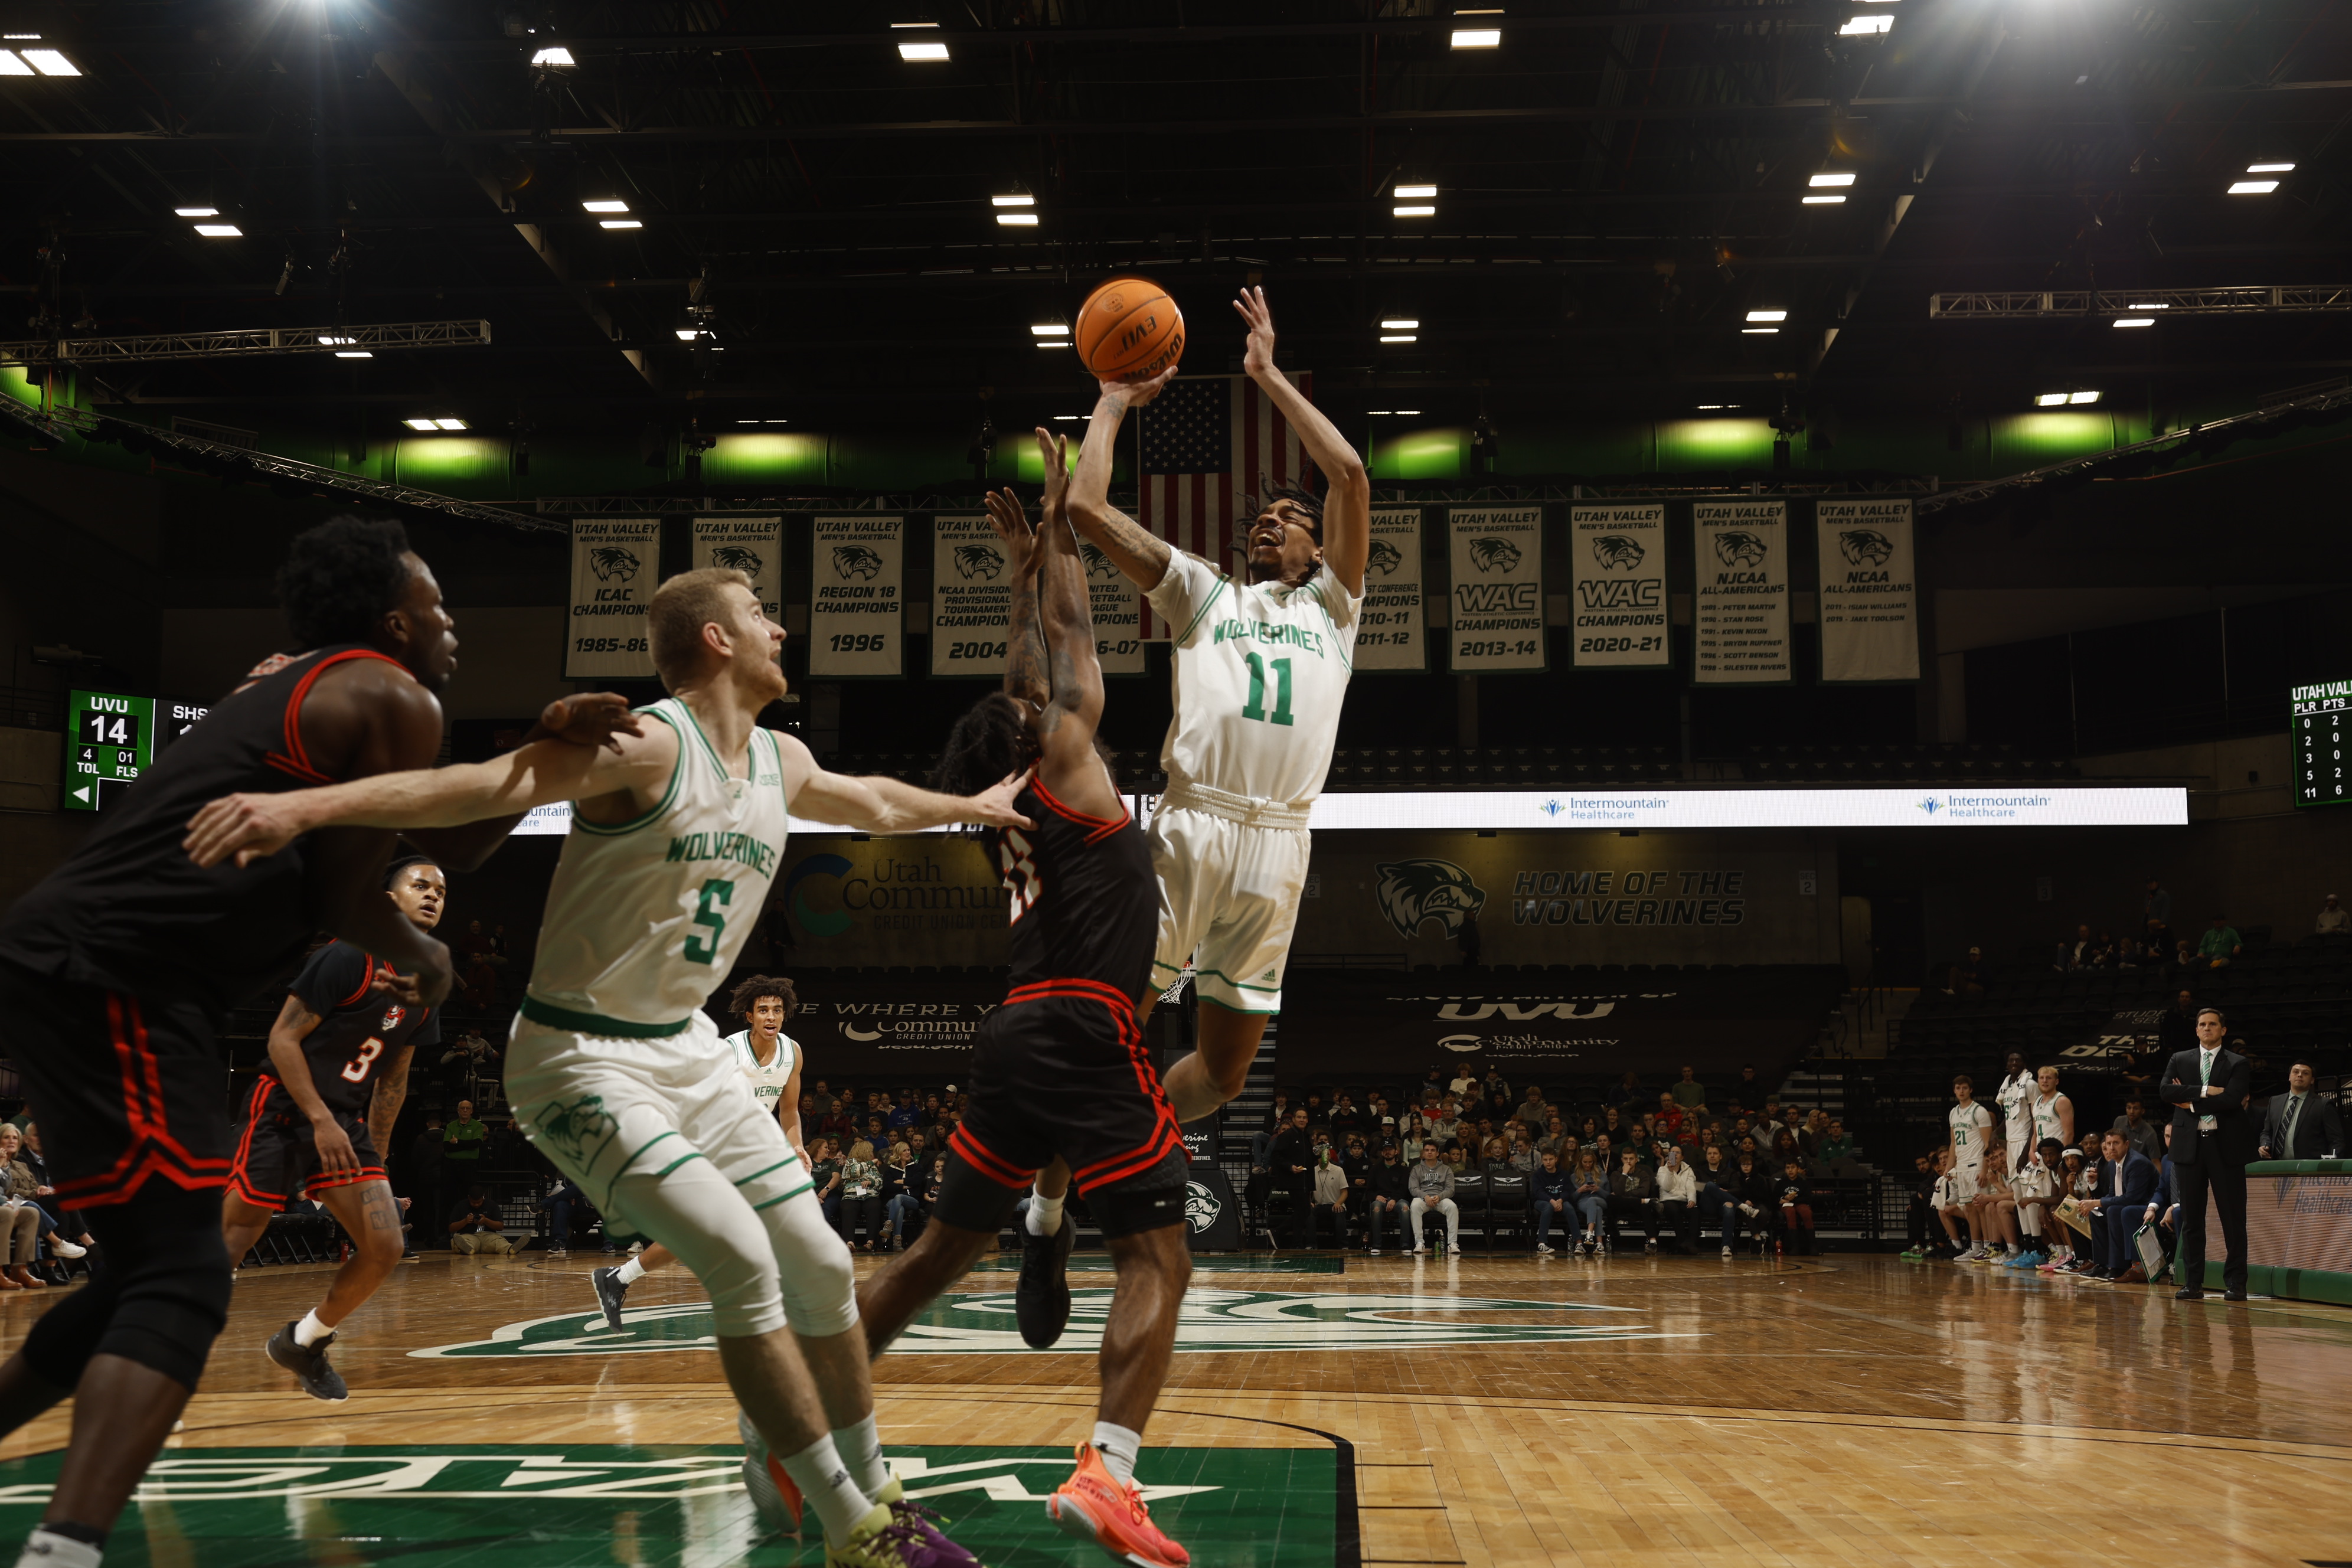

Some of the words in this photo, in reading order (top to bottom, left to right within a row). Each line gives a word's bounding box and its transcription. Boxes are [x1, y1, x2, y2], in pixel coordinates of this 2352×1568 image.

[1574, 511, 1611, 522] UTAH
[1613, 510, 1661, 521] VALLEY
[1697, 508, 1730, 518] UTAH
[1736, 507, 1784, 517] VALLEY
[1820, 506, 1854, 515] UTAH
[1860, 504, 1909, 515] VALLEY
[1371, 515, 1419, 525] VALLEY
[1451, 514, 1488, 524] UTAH
[1491, 512, 1538, 523] VALLEY
[575, 524, 610, 534] UTAH
[612, 524, 659, 534] VALLEY
[695, 523, 731, 533] UTAH
[733, 522, 780, 533] VALLEY
[816, 522, 852, 532] UTAH
[854, 521, 902, 532] VALLEY
[937, 522, 974, 531] UTAH
[1717, 573, 1766, 584] NJCAA
[1847, 571, 1889, 583] NCAA
[819, 586, 876, 598] REGION
[878, 586, 896, 598] 18
[1377, 583, 1418, 592] CONFERENCE
[1577, 579, 1661, 607] WAC
[1701, 584, 1784, 594] ALL-AMERICANS
[1824, 583, 1912, 593] ALL-AMERICANS
[594, 589, 633, 601] ICAC
[1362, 595, 1419, 607] MPIONS
[1455, 583, 1537, 612] WAC
[815, 602, 899, 613] CHAMPIONS
[936, 615, 1010, 626] CHAMPION
[1360, 612, 1409, 625] 010-11
[1455, 618, 1540, 631] CHAMPIONS
[1577, 615, 1664, 627] CHAMPIONS
[576, 638, 648, 652] 1985-86
[830, 634, 884, 652] 1996
[1214, 618, 1324, 659] WOLVERINES
[1355, 632, 1409, 645] 011-12
[1580, 637, 1662, 652] 2020-21
[949, 642, 1007, 659] 2004
[1096, 641, 1140, 654] 6-07
[1459, 641, 1536, 656] 2013-14
[1242, 652, 1293, 726] 11
[2292, 684, 2325, 701] UTAH
[90, 696, 128, 713] UVU
[173, 705, 208, 720] SHS
[2294, 701, 2317, 713] PLR
[2323, 698, 2345, 710] PTS
[2304, 718, 2311, 729] 0
[2332, 716, 2338, 726] 2
[90, 715, 128, 744] 14
[2305, 736, 2312, 746] 2
[2333, 732, 2340, 742] 0
[83, 748, 93, 760] 4
[118, 751, 133, 763] 01
[2306, 753, 2312, 763] 3
[2334, 750, 2340, 760] 0
[77, 762, 100, 775] TOL
[116, 766, 138, 778] FLS
[2307, 770, 2313, 780] 5
[2334, 767, 2341, 778] 2
[2305, 788, 2317, 798] 11
[2335, 785, 2342, 795] 6
[1571, 798, 1666, 808] Intermountain
[1949, 795, 2047, 806] Intermountain
[527, 806, 571, 816] untain
[1571, 810, 1635, 819] Healthcare
[1950, 808, 2015, 817] Healthcare
[666, 832, 775, 880] WOLVERINES
[873, 856, 943, 883] Utah
[1513, 870, 1614, 896] HOME
[1622, 870, 1667, 896] OF
[1678, 871, 1745, 895] THE
[1804, 881, 1811, 893] 2
[1309, 885, 1315, 896] 2
[1513, 899, 1745, 926] WOLVERINES
[684, 879, 734, 965] 5
[874, 916, 923, 930] CREDIT
[931, 916, 974, 930] UNION
[981, 916, 1007, 930] CEN
[834, 1003, 959, 1015] WHERE
[340, 1035, 384, 1083] 3
[1955, 1131, 1967, 1145] 21
